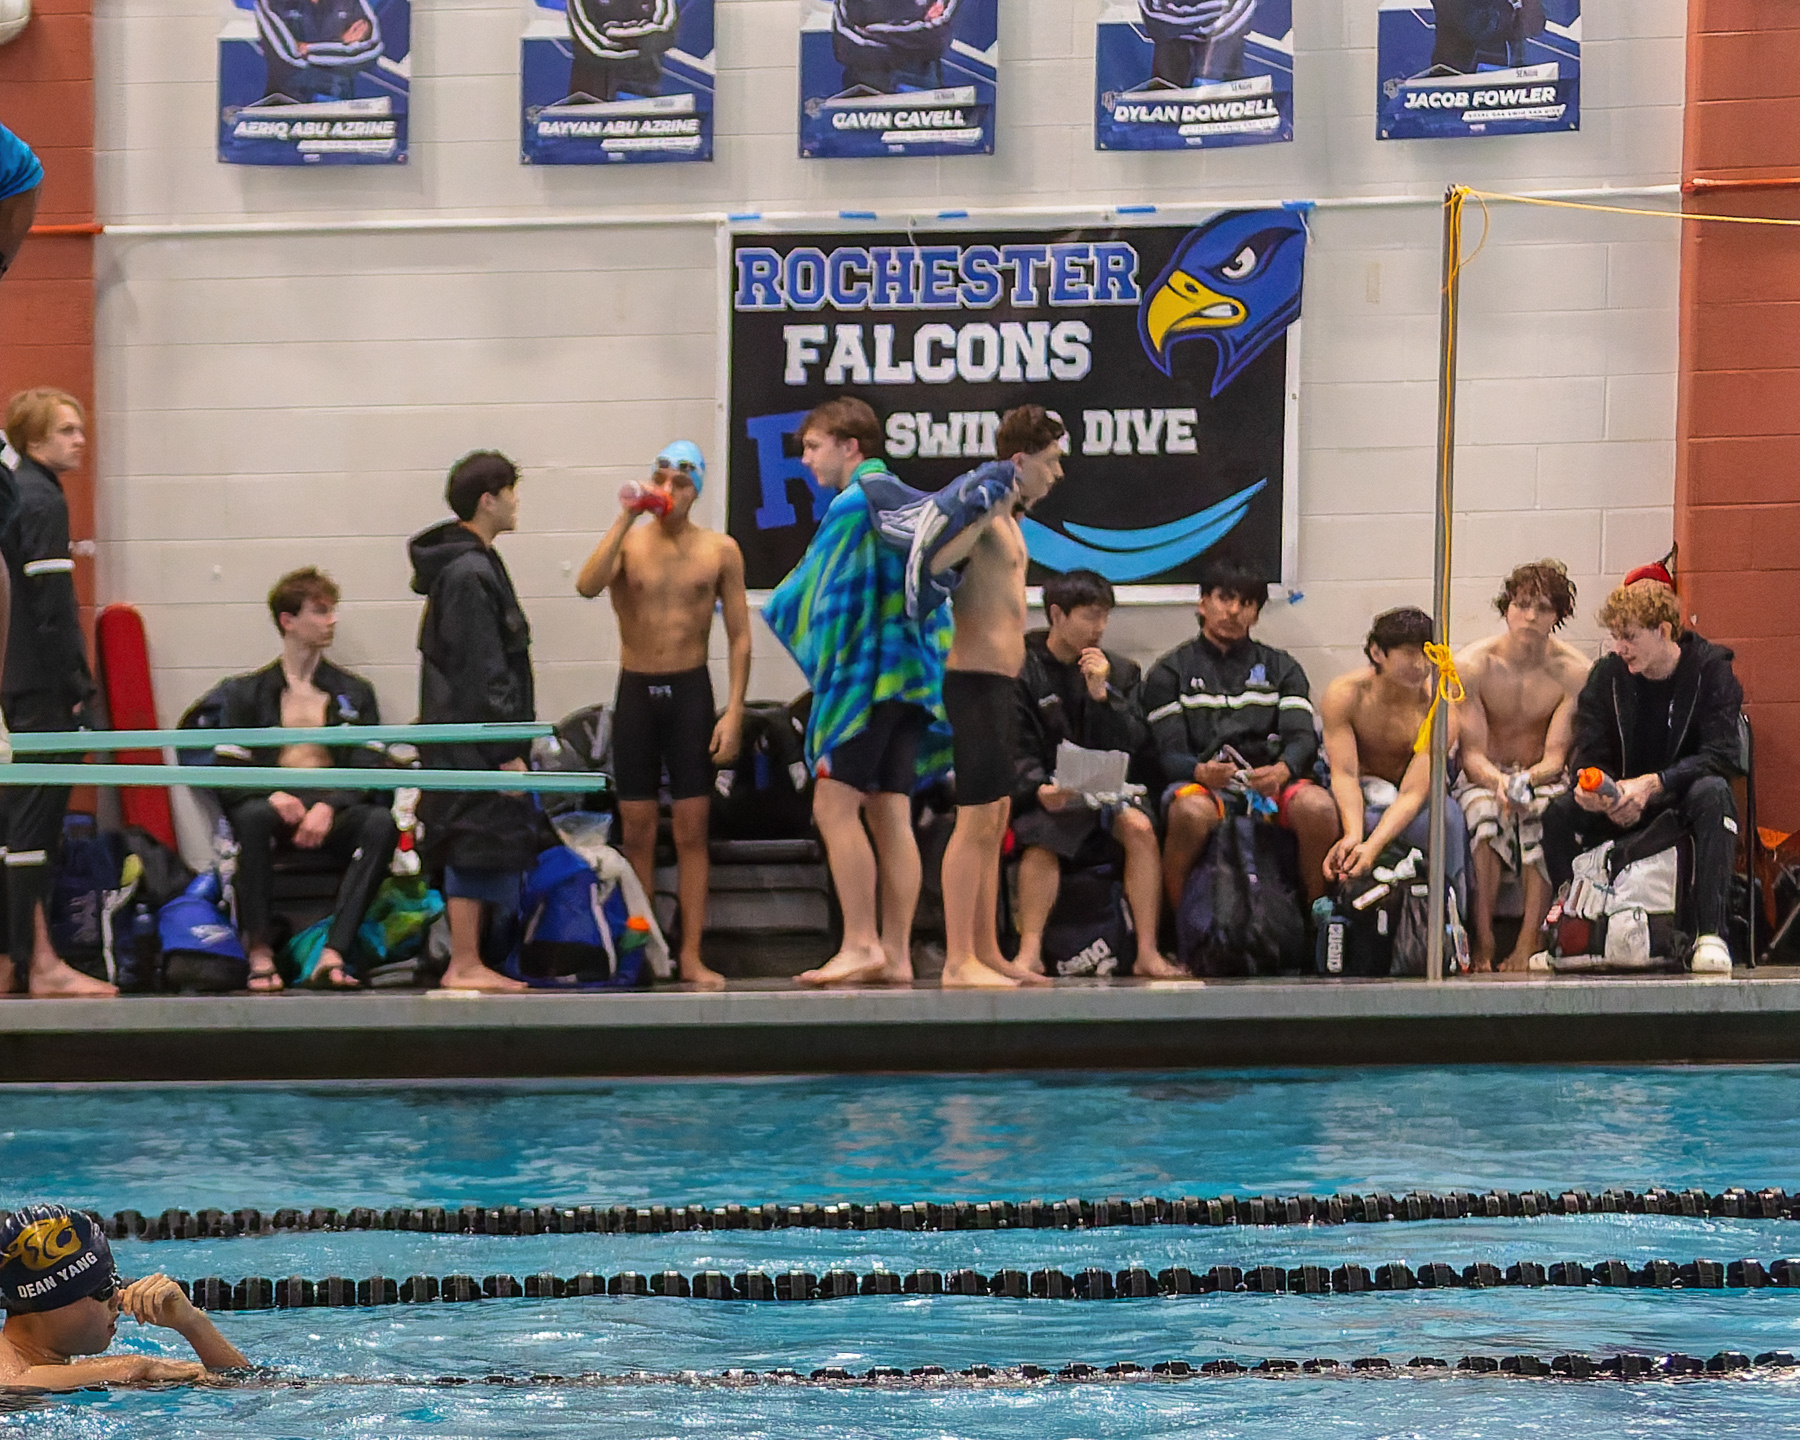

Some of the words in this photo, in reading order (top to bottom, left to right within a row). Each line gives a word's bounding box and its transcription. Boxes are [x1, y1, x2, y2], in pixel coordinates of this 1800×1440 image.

[1113, 105, 1180, 122] DYLAN
[1180, 98, 1279, 122] DOWDELL
[1403, 92, 1470, 109] JACOB
[1471, 87, 1557, 107] FOWLER
[290, 121, 331, 138] ABU
[602, 120, 638, 136] ABU
[832, 112, 892, 130] GAVIN
[893, 109, 966, 128] CAVELL
[734, 241, 1142, 311] ROCHESTER
[783, 320, 1093, 386] FALCONS
[1081, 408, 1199, 455] DIVE
[17, 1275, 58, 1299] DEAN
[56, 1251, 98, 1281] YANG
